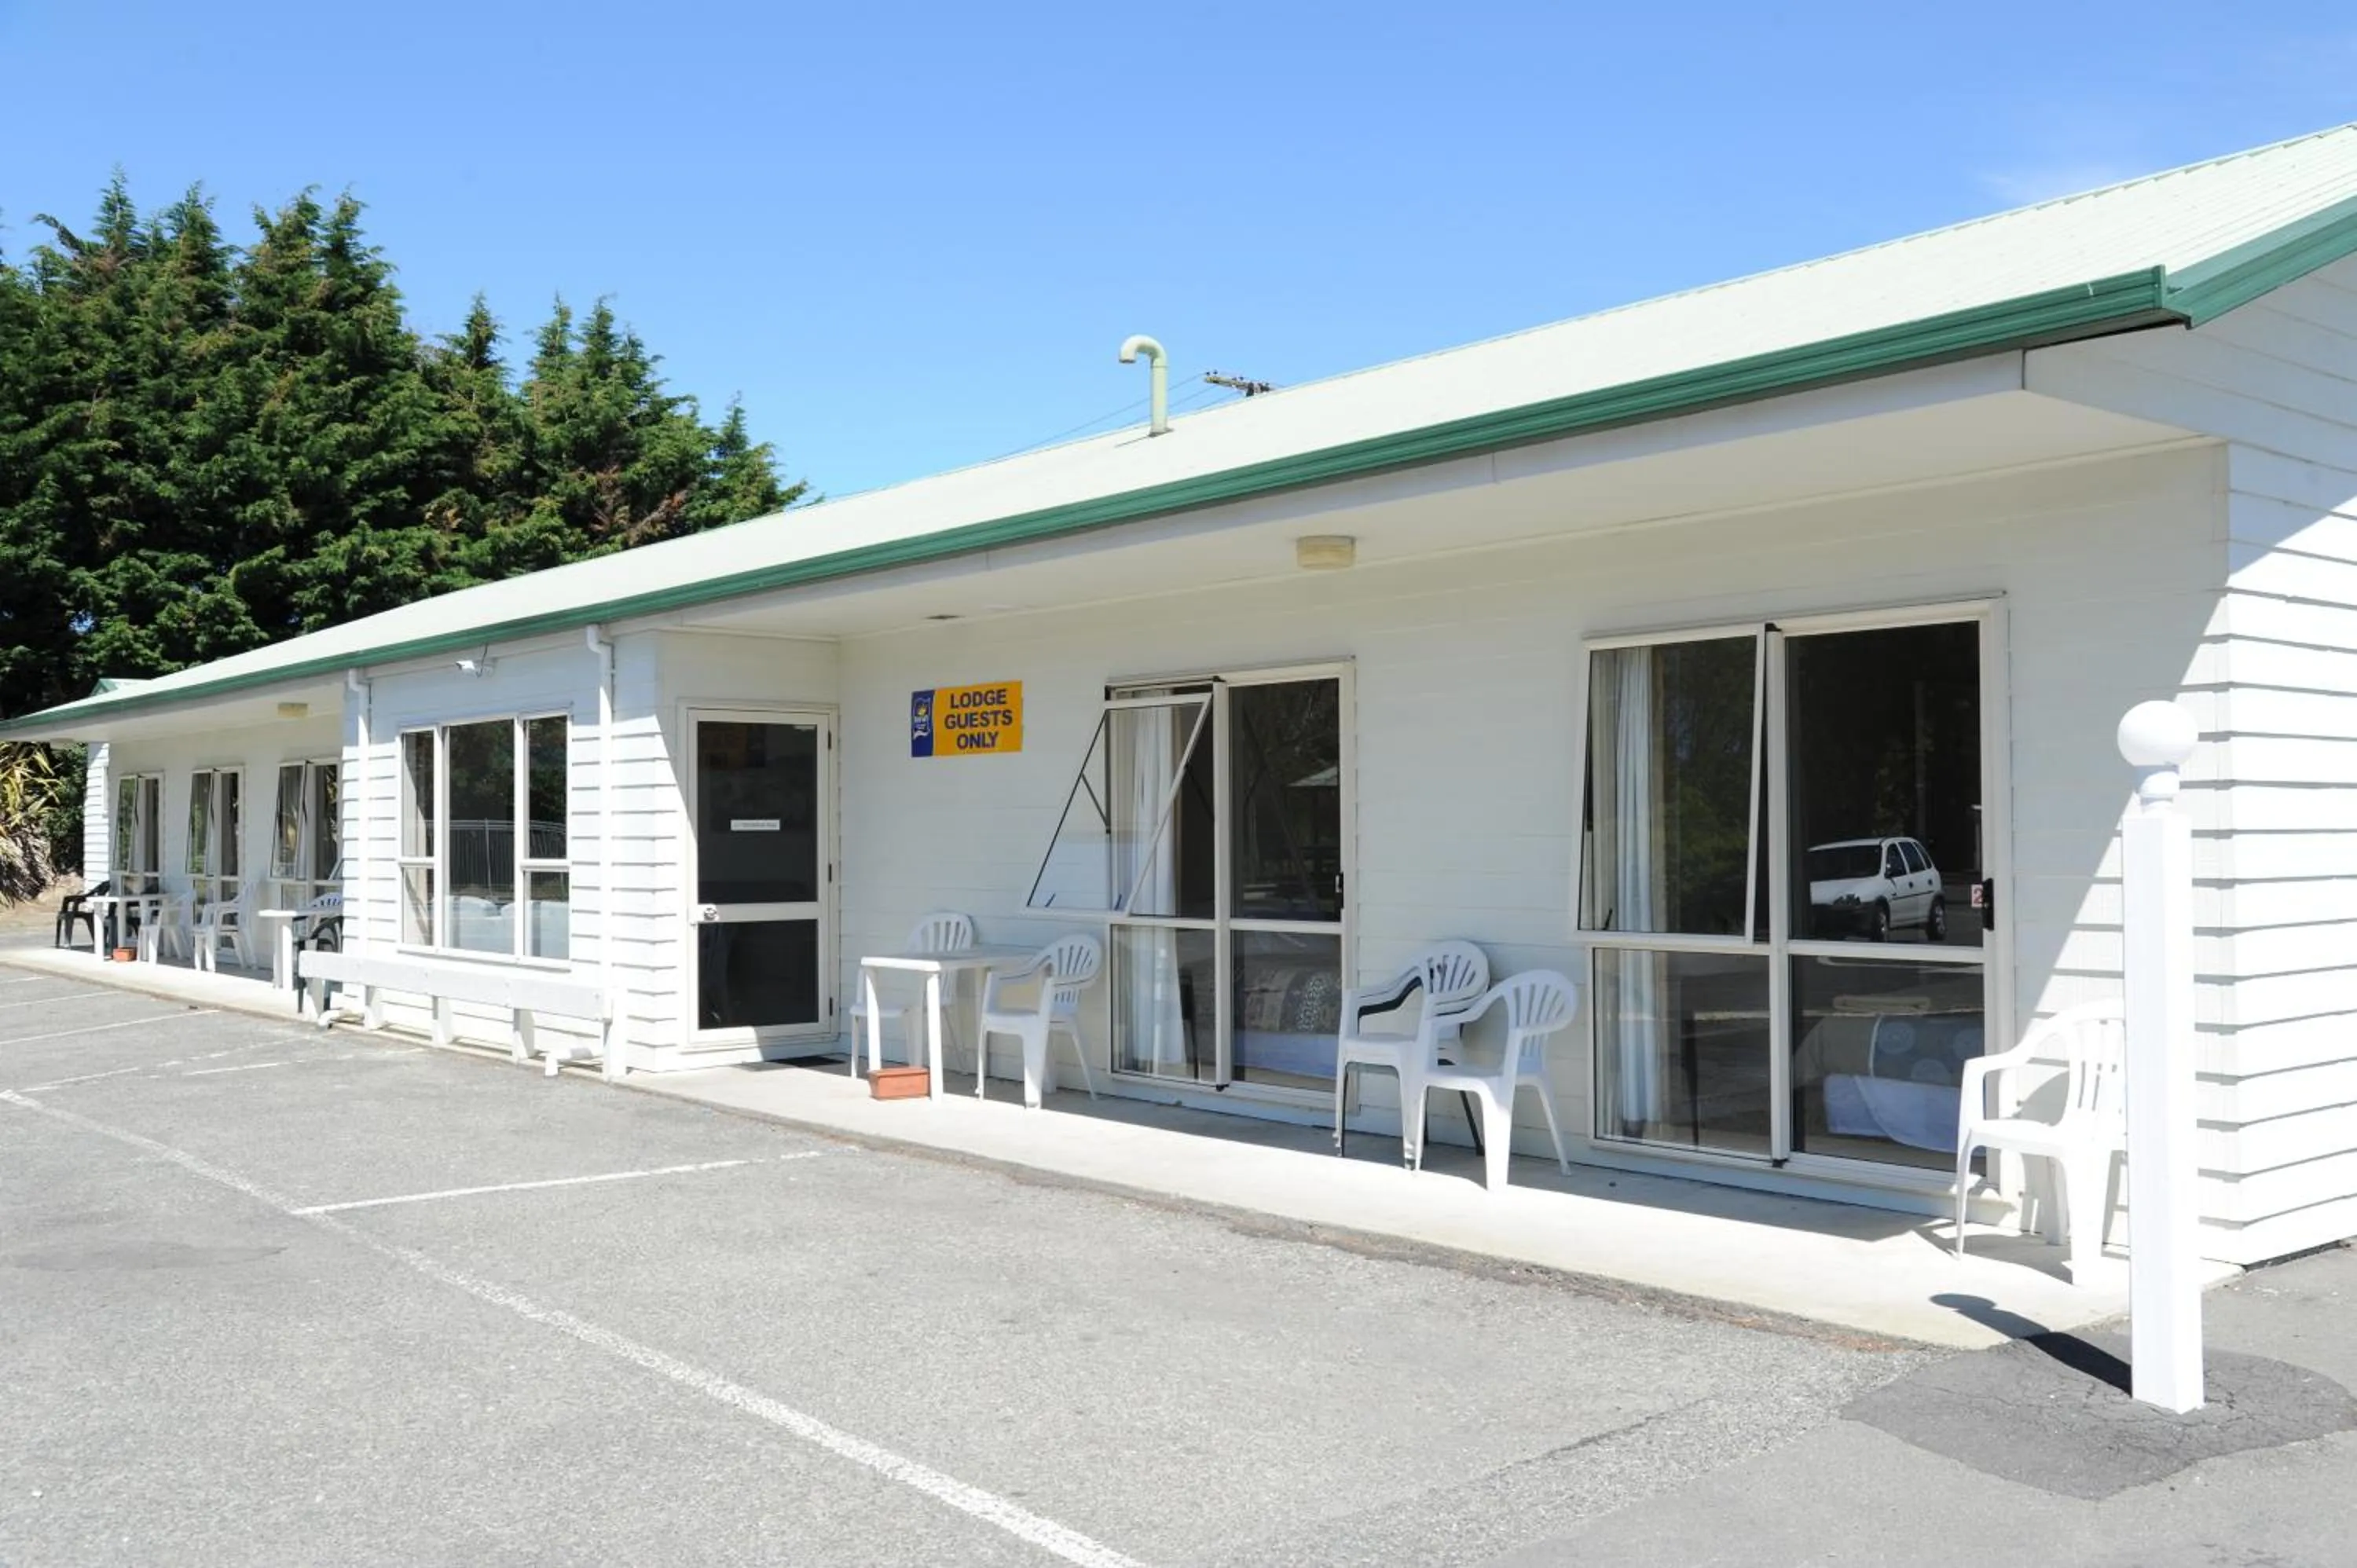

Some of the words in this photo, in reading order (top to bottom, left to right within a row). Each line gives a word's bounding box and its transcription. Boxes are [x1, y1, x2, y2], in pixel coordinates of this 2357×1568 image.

[951, 688, 1006, 709] LODGE
[944, 709, 1013, 729] GUESTS
[956, 732, 999, 749] ONLY
